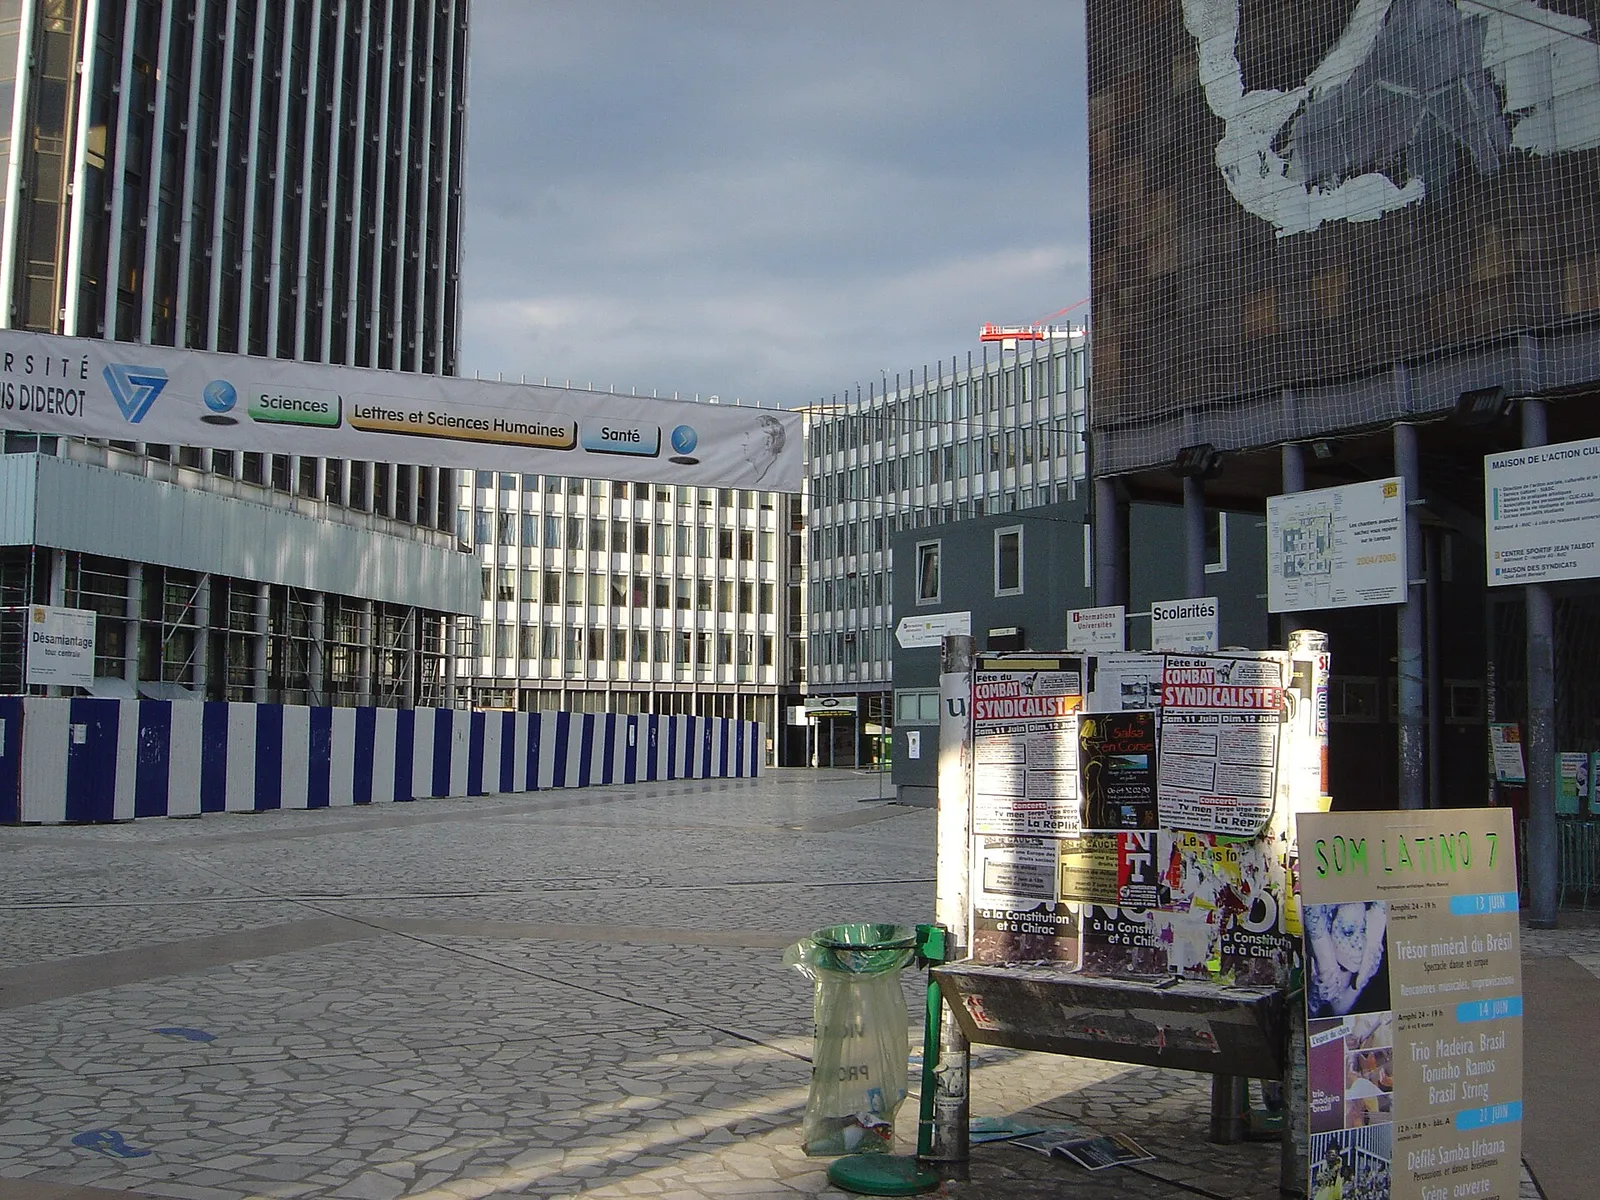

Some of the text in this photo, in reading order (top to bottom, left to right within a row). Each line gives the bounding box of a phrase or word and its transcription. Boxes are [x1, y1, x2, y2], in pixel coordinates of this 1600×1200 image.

[19, 384, 86, 417] DIDEROT
[259, 393, 329, 413] Sciences
[354, 404, 566, 438] Lettres et Sciences Humaines
[600, 425, 641, 444] Santé
[1492, 446, 1600, 470] MAISON DE L'ACTION CUL
[1501, 541, 1595, 558] CENTRE SPORTIF JEAN TALBOT
[1501, 566, 1526, 574] MAISON
[1541, 560, 1578, 571] SYNDICATS
[1153, 603, 1215, 621] Scolarités
[32, 631, 93, 649] Désamiantage
[1167, 658, 1207, 667] Fête du
[976, 673, 1012, 682] Fête du
[1165, 668, 1214, 685] COMBAT
[975, 681, 1019, 699] COMBAT
[1165, 686, 1273, 708] SYNDICALISTE
[975, 697, 1065, 719] SYNDICALIST
[1198, 715, 1218, 723] Juin
[1258, 715, 1279, 723] Juin
[1007, 725, 1025, 733] Juin
[1113, 723, 1144, 739] Salsa
[1102, 740, 1154, 752] en Corse
[1028, 819, 1040, 828] La
[1214, 815, 1228, 825] La
[1315, 831, 1498, 879] SOM LATINO 7
[1390, 903, 1411, 912] Amphi
[1475, 895, 1506, 913] 13 JUIN
[993, 909, 1003, 919] la
[1005, 910, 1070, 925] Constitution
[996, 920, 1055, 935] et à Chirac
[1093, 919, 1115, 932] à la
[1108, 933, 1130, 946] et à
[1396, 932, 1513, 960] Trésor minéral du Brésil
[1222, 943, 1247, 956] et à
[1423, 961, 1447, 974] Spectacle
[1449, 960, 1464, 969] danse
[1466, 960, 1472, 968] et
[1401, 984, 1436, 996] Rencontres
[1398, 1012, 1417, 1022] Amphi
[1418, 1011, 1425, 1019] 24
[1478, 1000, 1509, 1018] 14 JUIN
[1410, 1030, 1505, 1061] Trio Madeira Brasil
[1421, 1058, 1496, 1083] Toninho Ramos
[1312, 1089, 1325, 1098] trio
[1312, 1094, 1340, 1106] madeira
[1429, 1079, 1489, 1105] Brasil String
[1312, 1103, 1332, 1113] brasil
[1479, 1104, 1508, 1123] 21 JUIN
[1397, 1125, 1404, 1133] 12
[1444, 1117, 1450, 1125] A
[1407, 1138, 1506, 1171] Défilé Samba Urbana
[1413, 1169, 1441, 1182] Percussions
[1444, 1168, 1450, 1176] et
[1451, 1164, 1469, 1174] danses
[1421, 1178, 1491, 1200] Scène ouverte
